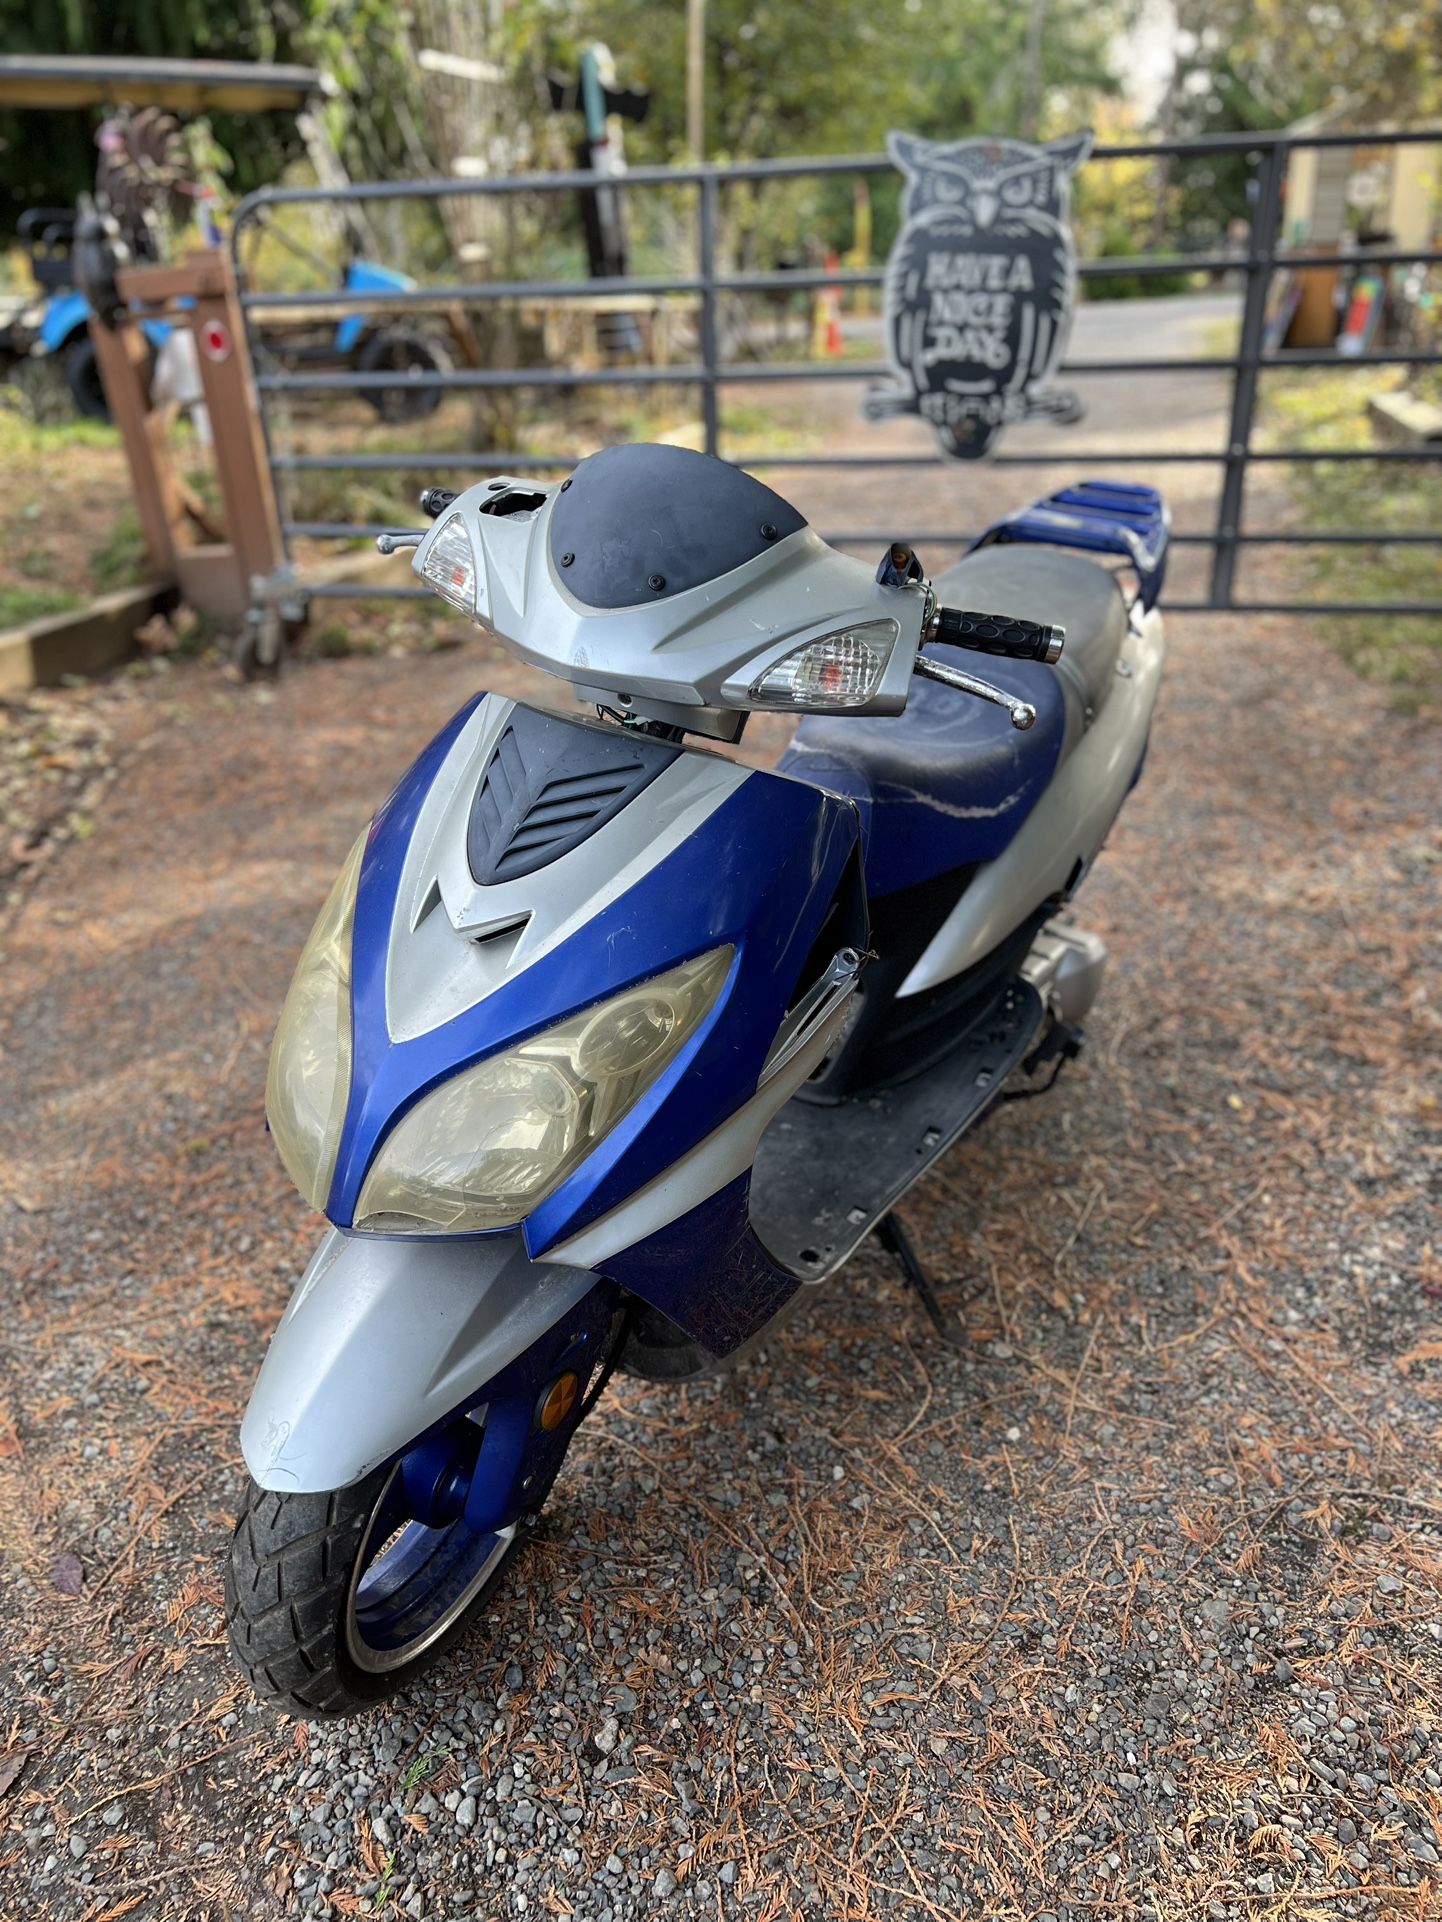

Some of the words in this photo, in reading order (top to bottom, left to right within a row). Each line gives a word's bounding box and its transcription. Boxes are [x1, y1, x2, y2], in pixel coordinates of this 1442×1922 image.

[925, 251, 1008, 291] HAVE
[1007, 254, 1035, 292] A
[928, 291, 1014, 327] NICE
[922, 326, 1011, 370] DAY
